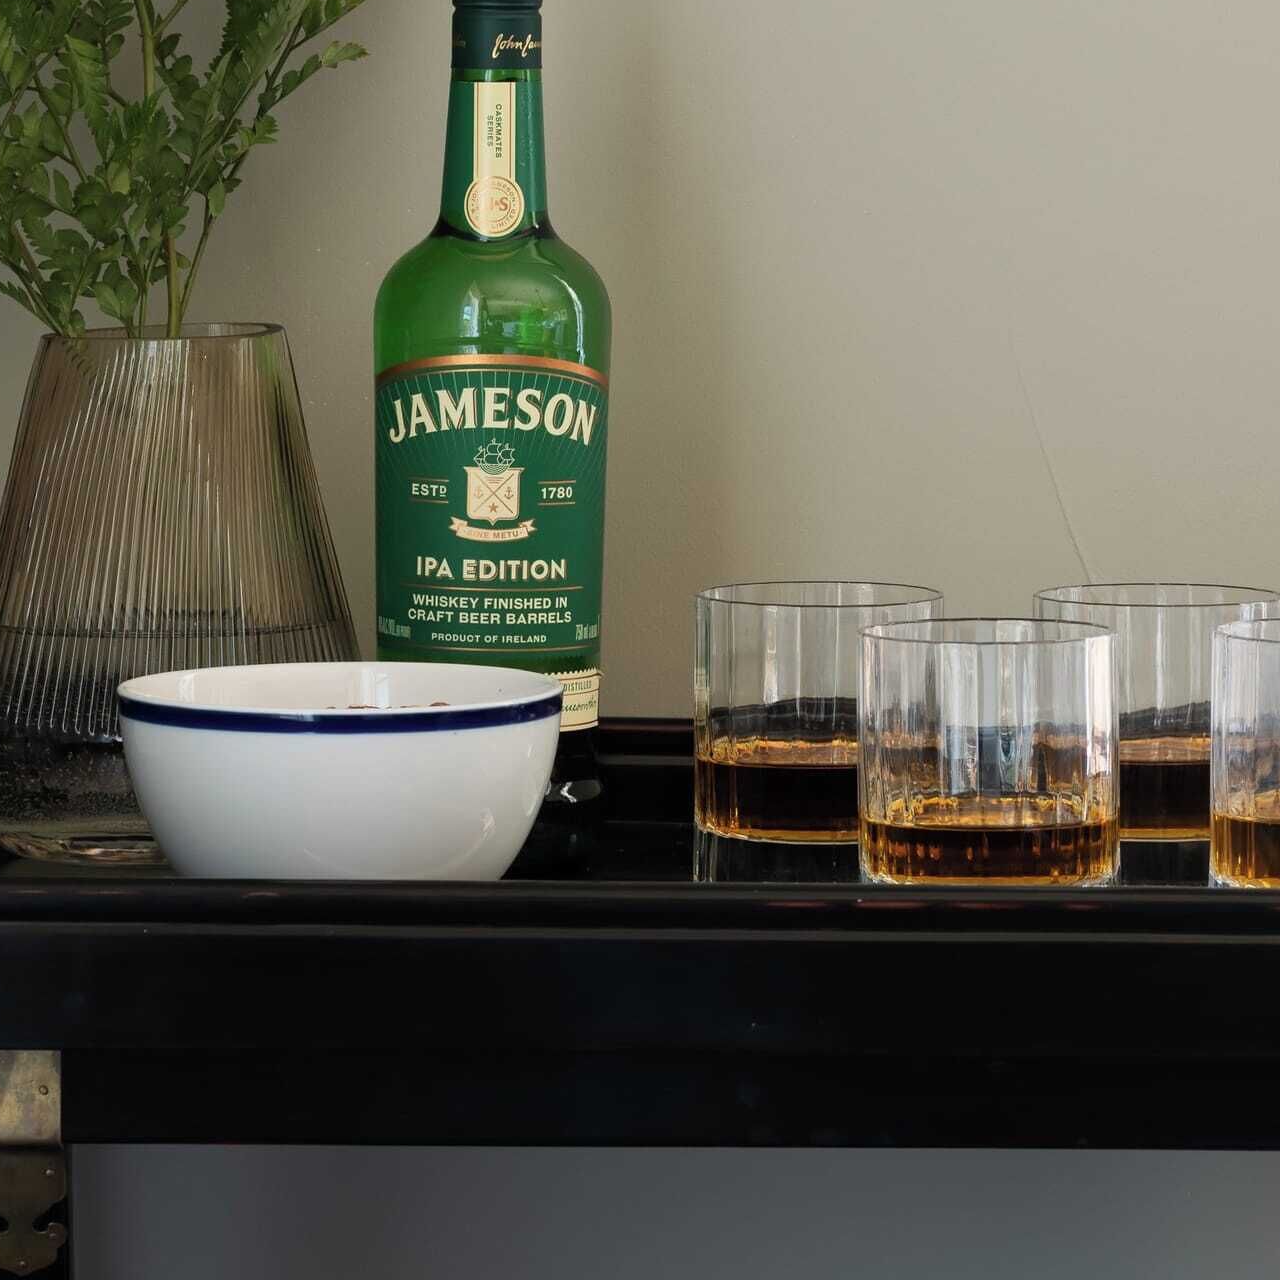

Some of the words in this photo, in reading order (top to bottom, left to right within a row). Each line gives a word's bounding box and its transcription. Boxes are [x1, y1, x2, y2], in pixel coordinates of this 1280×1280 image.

[389, 387, 597, 446] JAMESON
[541, 486, 573, 500] 1780
[492, 529, 519, 539] METU
[417, 556, 455, 580] IPA
[462, 558, 567, 581] EDITION
[412, 593, 479, 609] WHISKEY
[484, 597, 552, 610] FINISHED
[556, 596, 568, 609] IN
[408, 608, 454, 623] CRAFT
[459, 612, 501, 625] BEER
[506, 611, 572, 625] BARRELS
[431, 632, 481, 643] PRODUCT
[484, 635, 498, 643] OF
[502, 635, 547, 644] IRELAND
